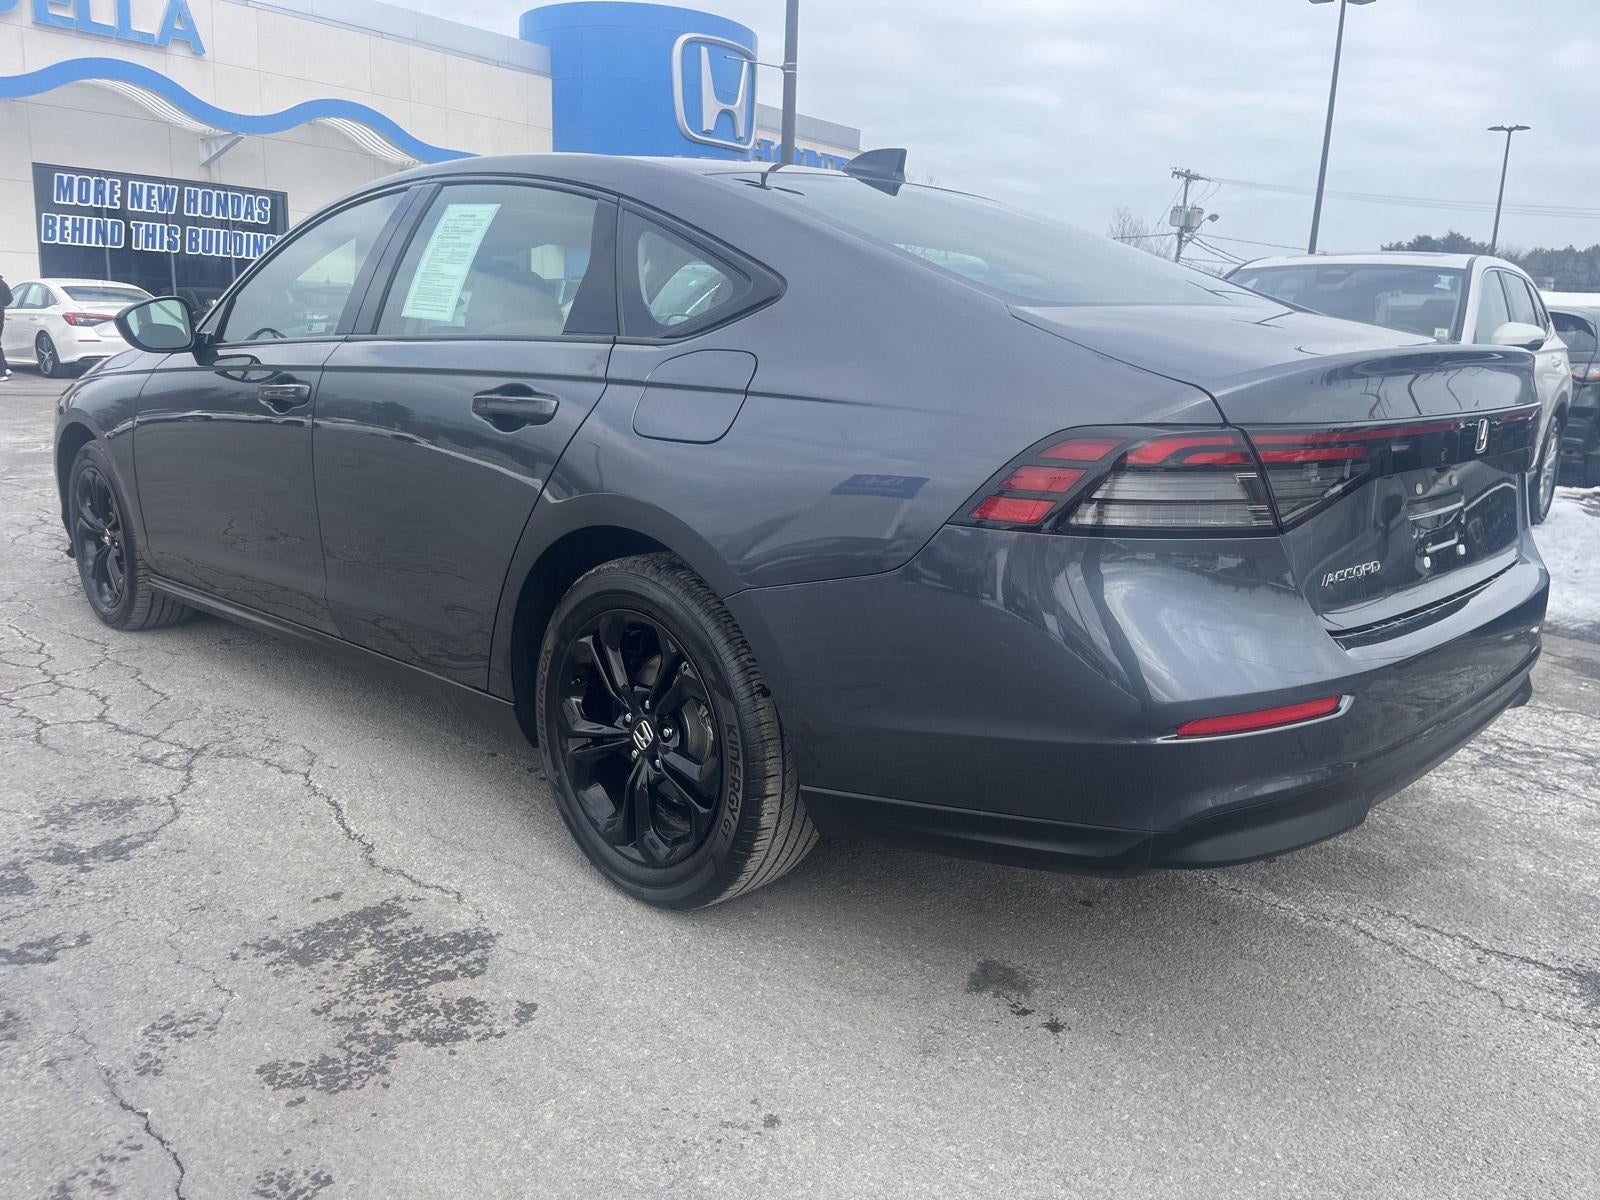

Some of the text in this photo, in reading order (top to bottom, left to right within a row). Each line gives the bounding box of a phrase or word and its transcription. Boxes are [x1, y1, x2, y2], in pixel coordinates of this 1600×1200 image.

[54, 173, 271, 224] MORE NEW HONDAS
[41, 213, 125, 248] BEHIND
[131, 221, 180, 254] THIS
[1321, 560, 1381, 587] ACCORD
[724, 722, 742, 821] KINERGY
